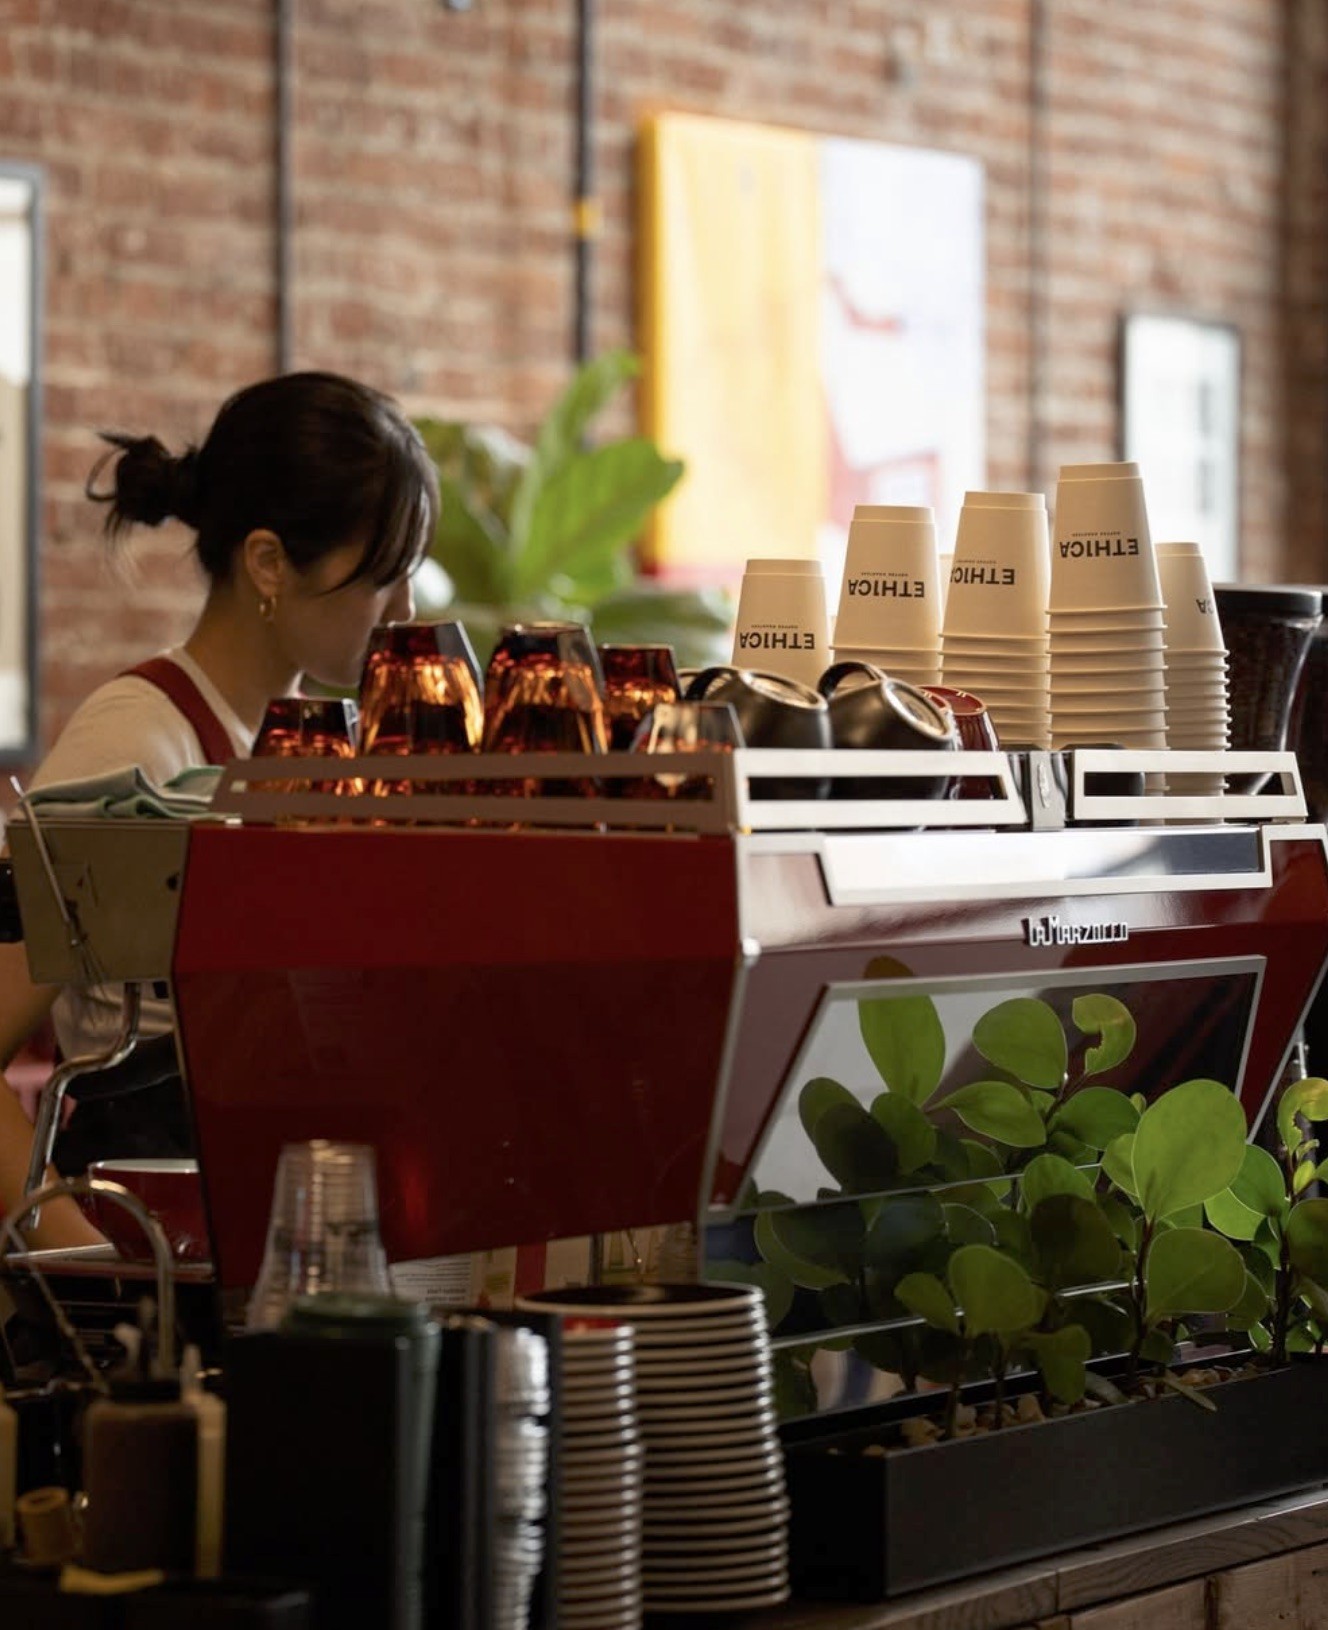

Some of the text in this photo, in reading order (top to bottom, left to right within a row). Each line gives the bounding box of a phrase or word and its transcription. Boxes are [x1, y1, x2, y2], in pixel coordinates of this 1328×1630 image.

[1059, 538, 1139, 558] ETHICA
[848, 579, 925, 598] ETHICA
[739, 632, 815, 650] ETHICA
